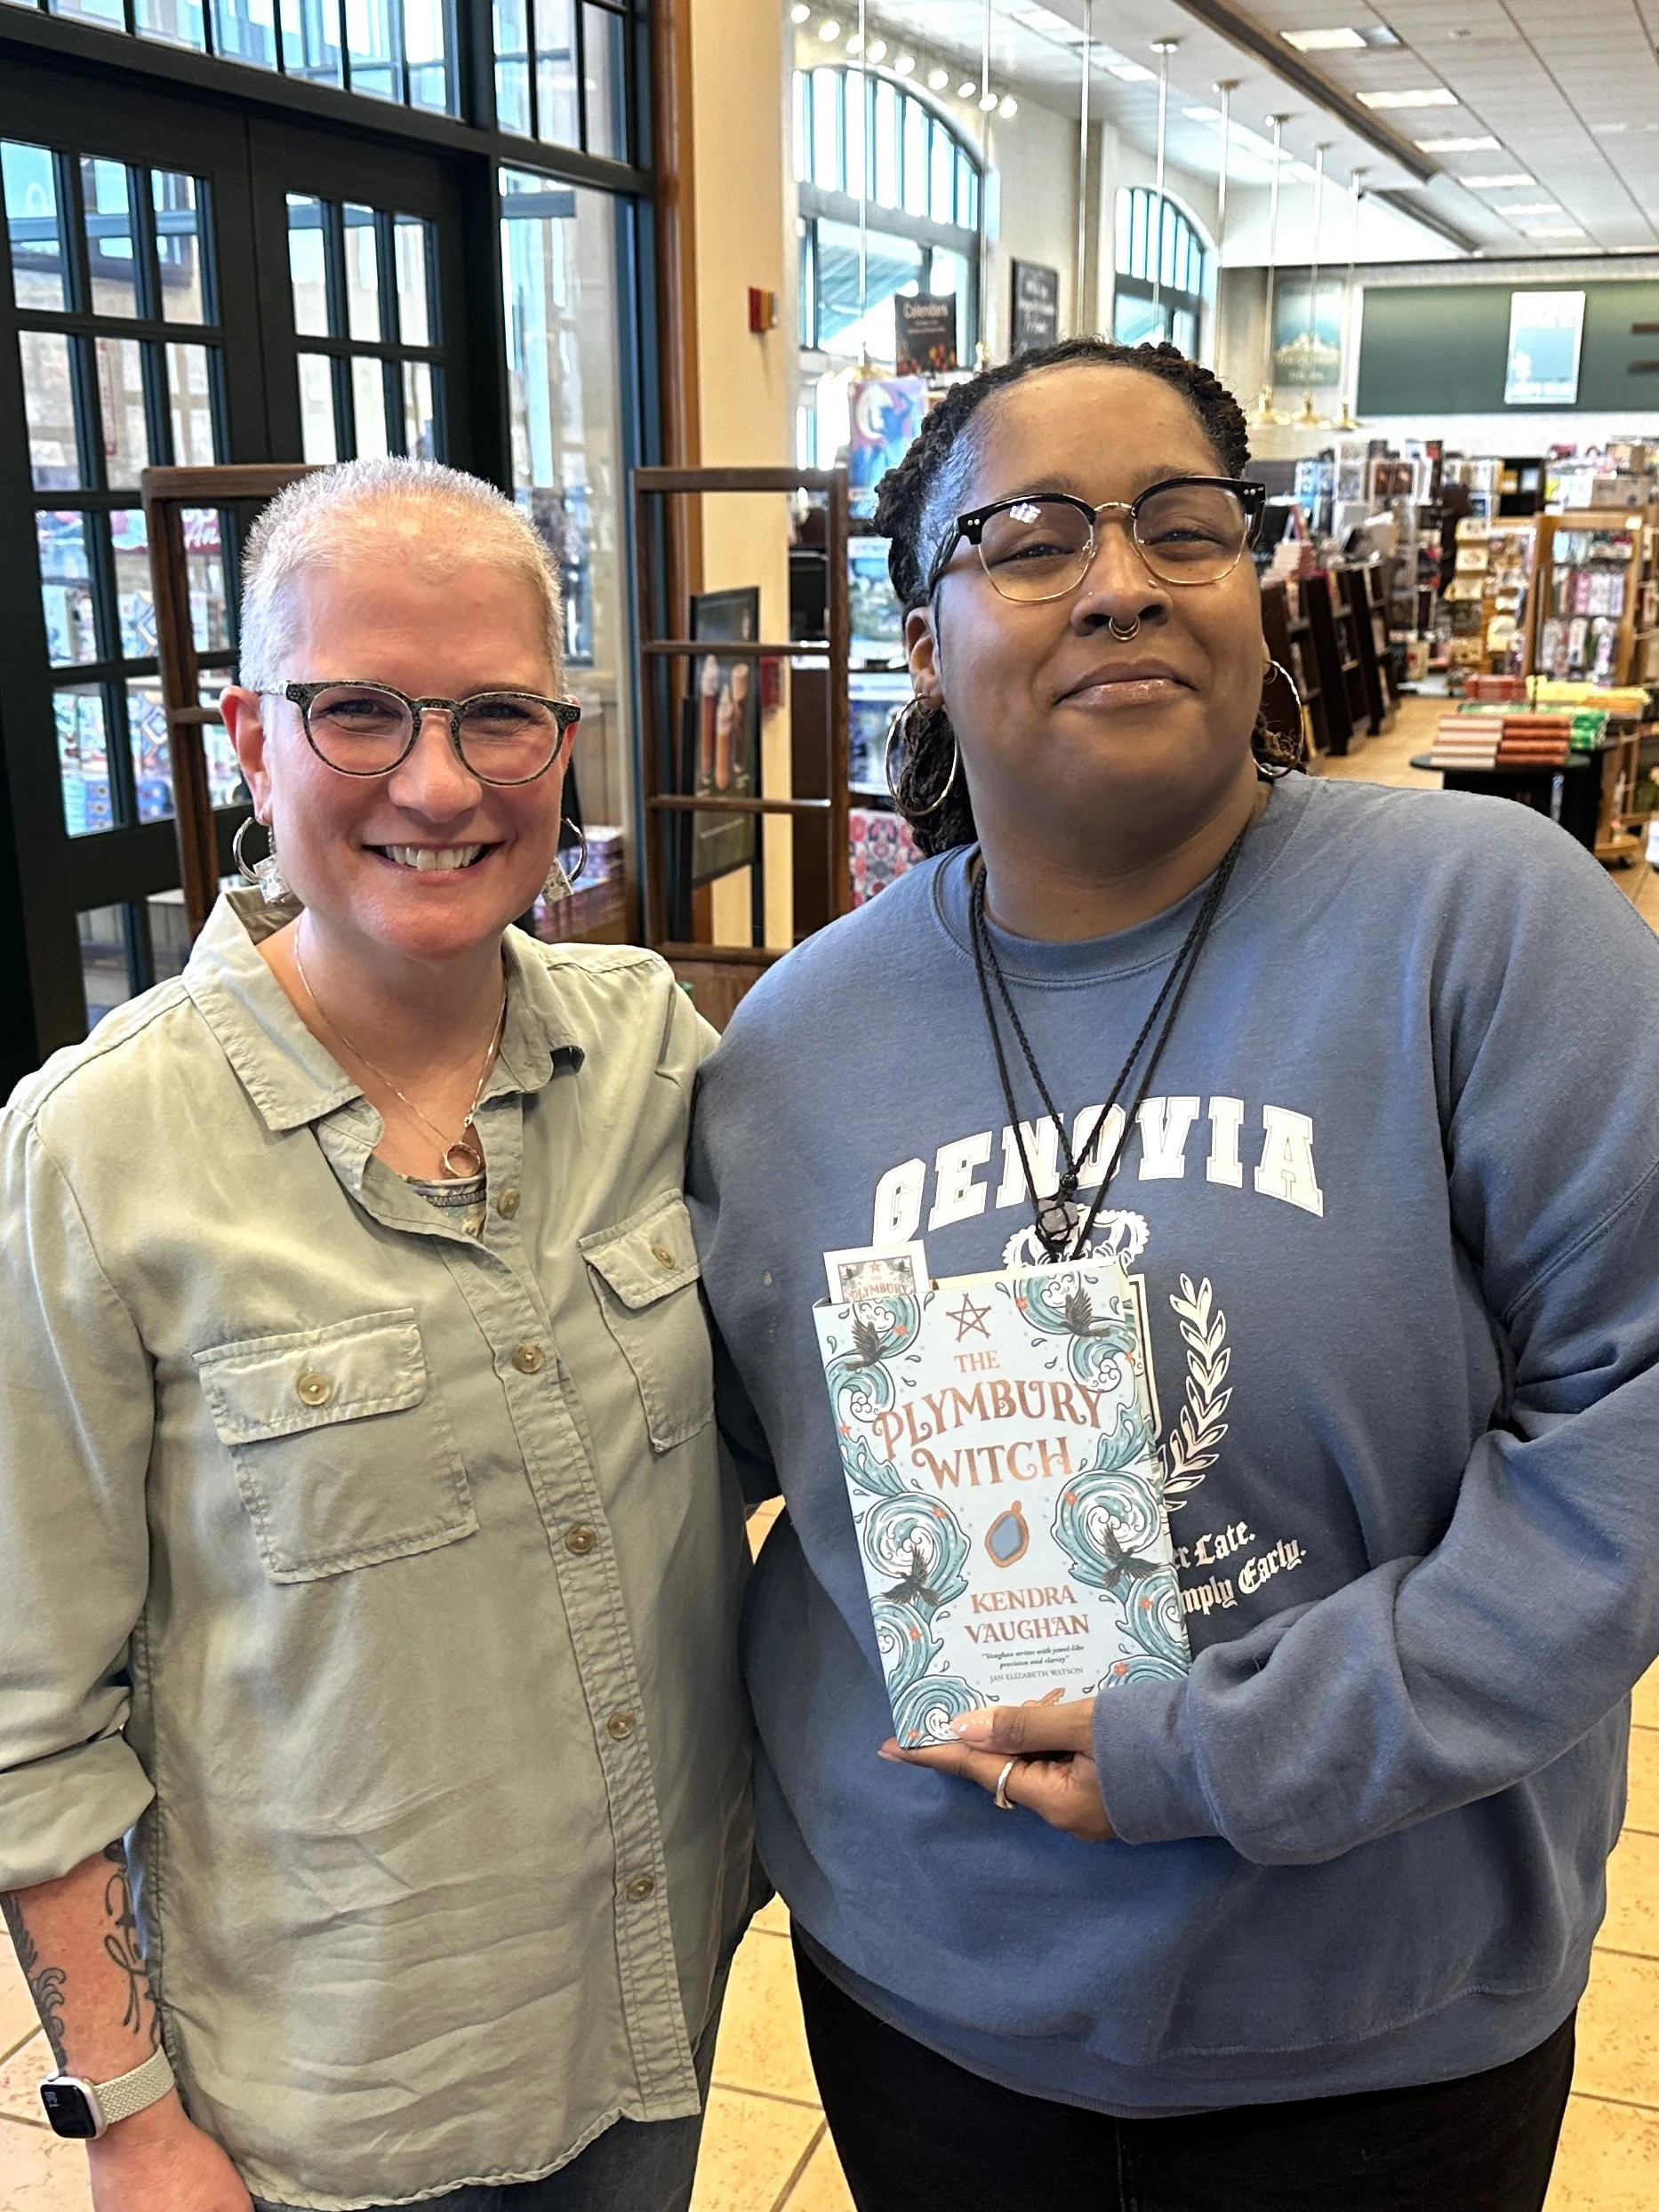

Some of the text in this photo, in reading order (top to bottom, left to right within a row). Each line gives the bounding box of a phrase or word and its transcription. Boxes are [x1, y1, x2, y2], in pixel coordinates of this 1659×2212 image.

[872, 1096, 1324, 1246] GENOVIA
[849, 1282, 907, 1301] PLYMBURY
[953, 1350, 1001, 1374] THE
[871, 1379, 1103, 1461] PLYMBURY
[910, 1436, 1073, 1491] WITCH
[1194, 1521, 1256, 1567] Late.
[1180, 1575, 1238, 1615] mply
[1238, 1539, 1307, 1594] Early.
[971, 1584, 1078, 1614] KENDRA
[964, 1614, 1090, 1644] VAUGHAN
[999, 1660, 1029, 1670] precision
[1037, 1647, 1052, 1655] with
[990, 1666, 1084, 1683] JAN ELIZABETH WATSON
